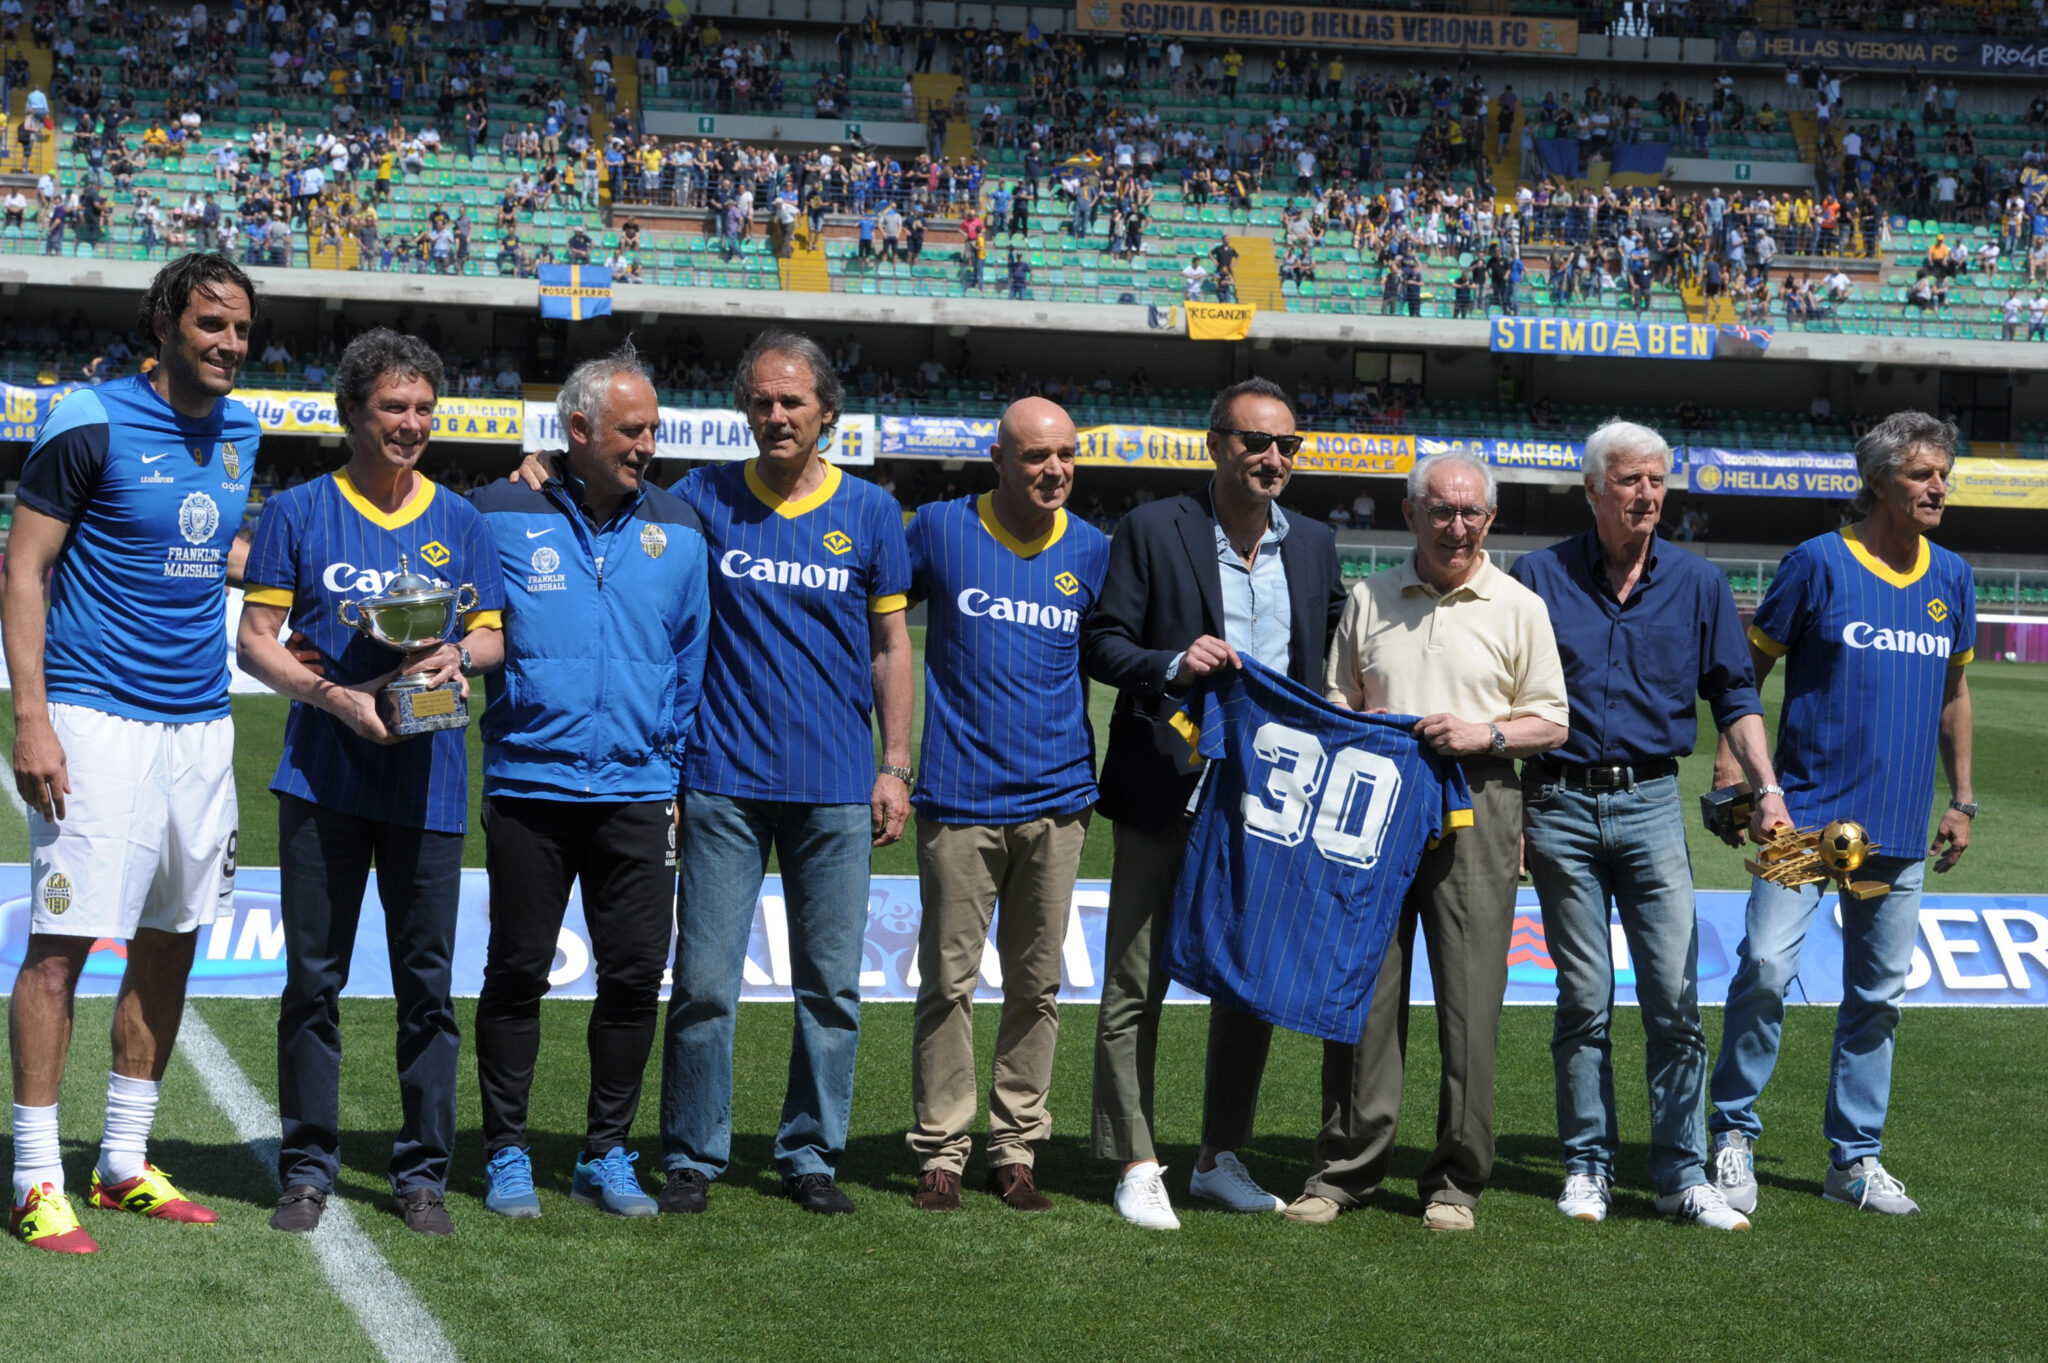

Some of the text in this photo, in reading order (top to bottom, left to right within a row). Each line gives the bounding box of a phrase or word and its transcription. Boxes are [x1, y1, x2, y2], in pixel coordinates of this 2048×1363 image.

[1120, 3, 1528, 47] SCUOLA CALCIO HELLAS VERONA FC
[1764, 38, 1958, 63] HELLAS VERONA FC
[431, 418, 518, 434] OGARA
[655, 418, 692, 444] AIR
[1316, 436, 1409, 456] NOGARA
[1297, 456, 1396, 470] ENTRALE
[1724, 471, 1799, 490] HELLAS
[167, 547, 220, 562] FRANKLIN
[163, 563, 219, 578] MARSHALL
[528, 574, 565, 584] FRANKLIN
[720, 550, 849, 592] Canon
[527, 582, 567, 592] MARSHALL
[957, 588, 1078, 632] Canon
[1842, 621, 1950, 659] Canon
[1240, 721, 1402, 869] 30
[206, 908, 286, 960] IM
